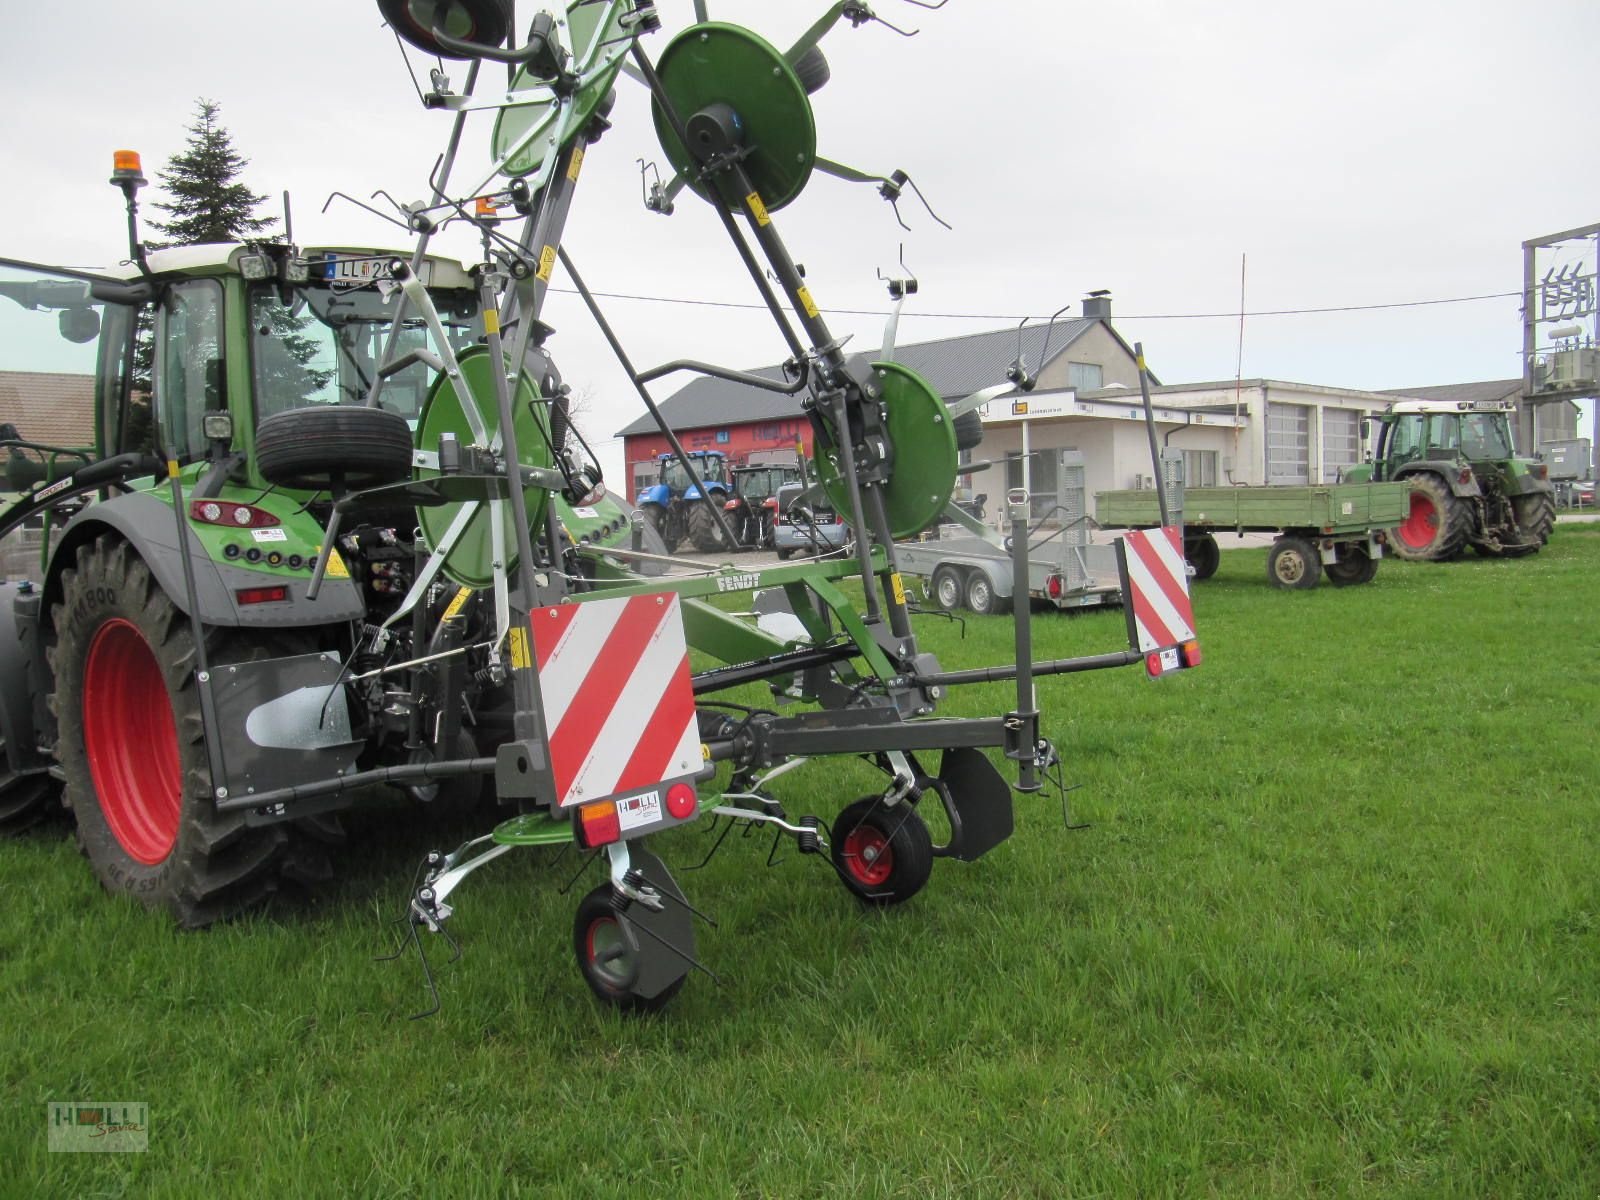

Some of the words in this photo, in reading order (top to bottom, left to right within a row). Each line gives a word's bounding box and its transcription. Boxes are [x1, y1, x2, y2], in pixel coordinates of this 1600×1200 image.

[342, 261, 358, 277] LL
[716, 573, 761, 591] FENDT
[619, 793, 657, 813] HOLLI
